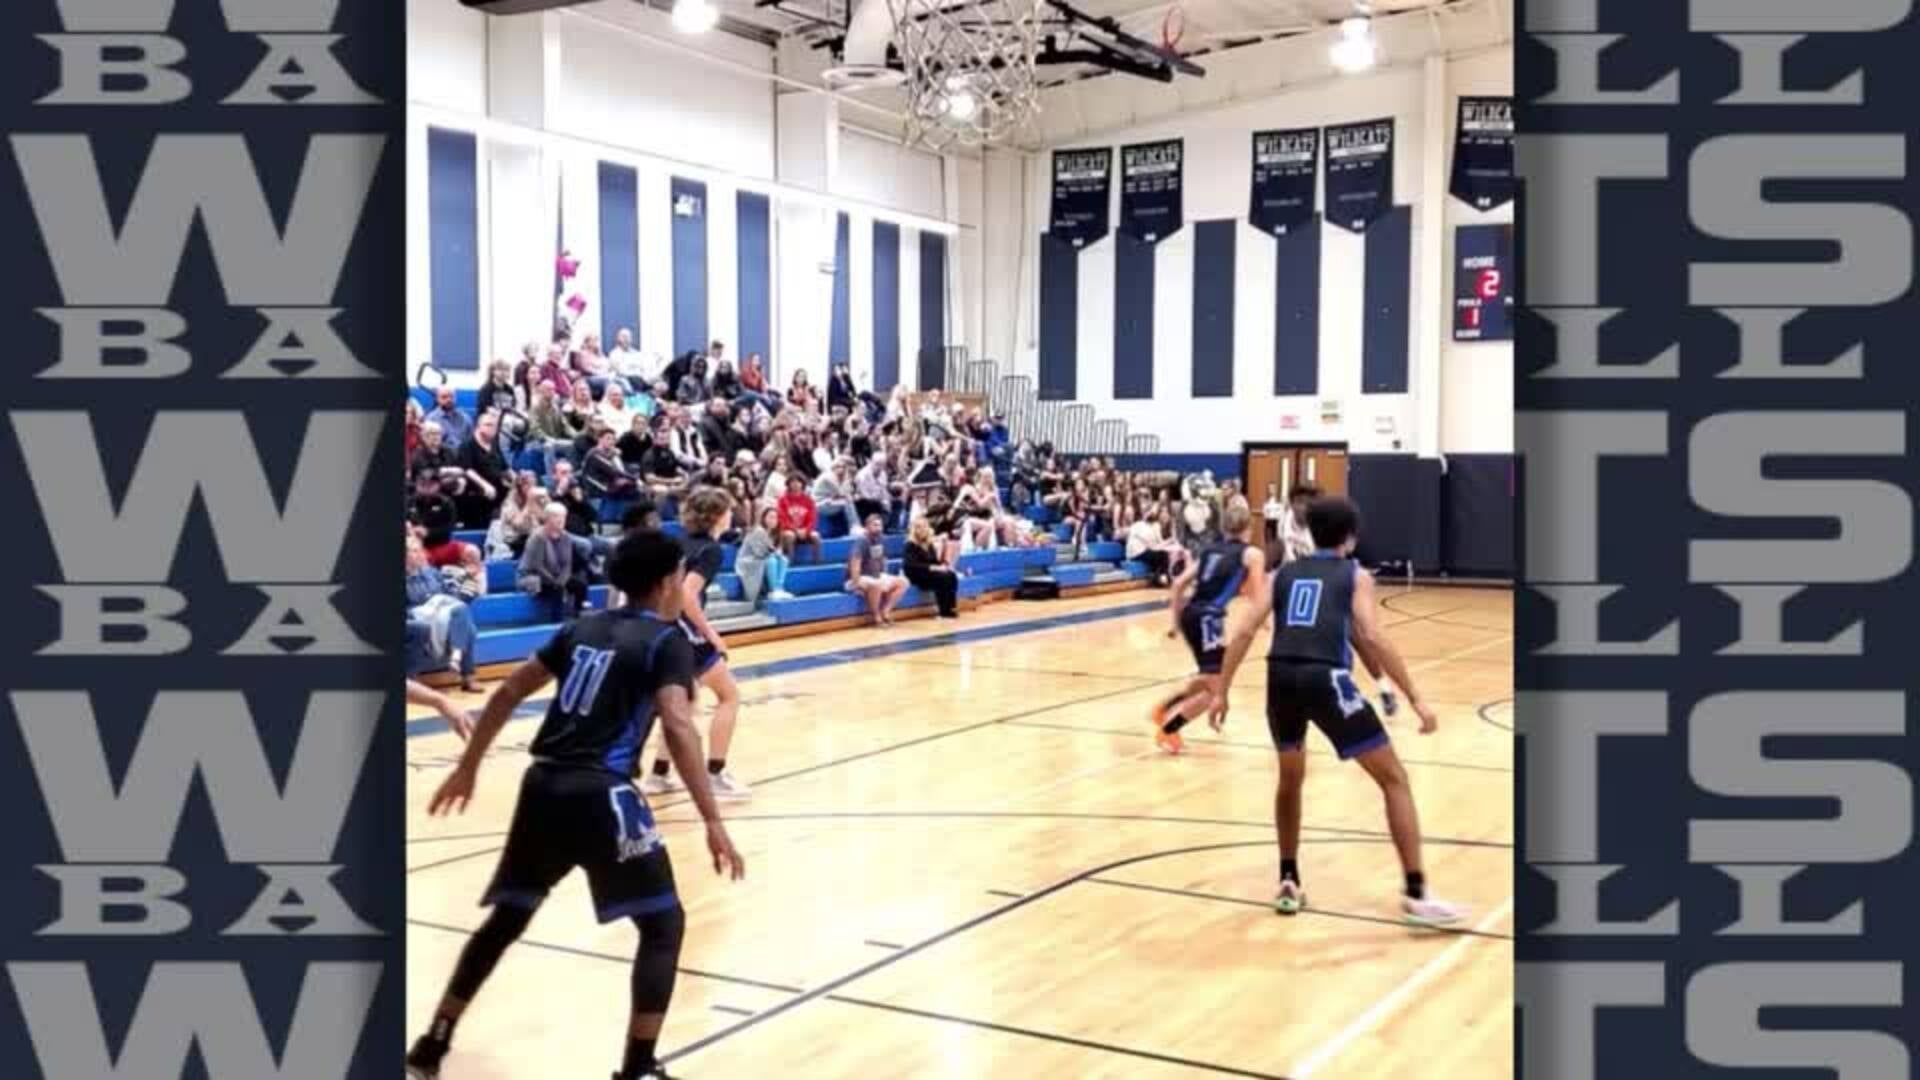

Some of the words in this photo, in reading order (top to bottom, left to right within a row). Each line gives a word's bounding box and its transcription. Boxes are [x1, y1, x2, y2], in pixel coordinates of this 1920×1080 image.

[1256, 132, 1315, 154] WILDCATS
[1328, 124, 1391, 149] WILDCATS
[1056, 153, 1108, 173] WILDCATS
[1125, 143, 1181, 166] WILDCATS
[1483, 270, 1500, 296] 2
[1287, 578, 1323, 626] 0
[560, 645, 616, 717] 11
